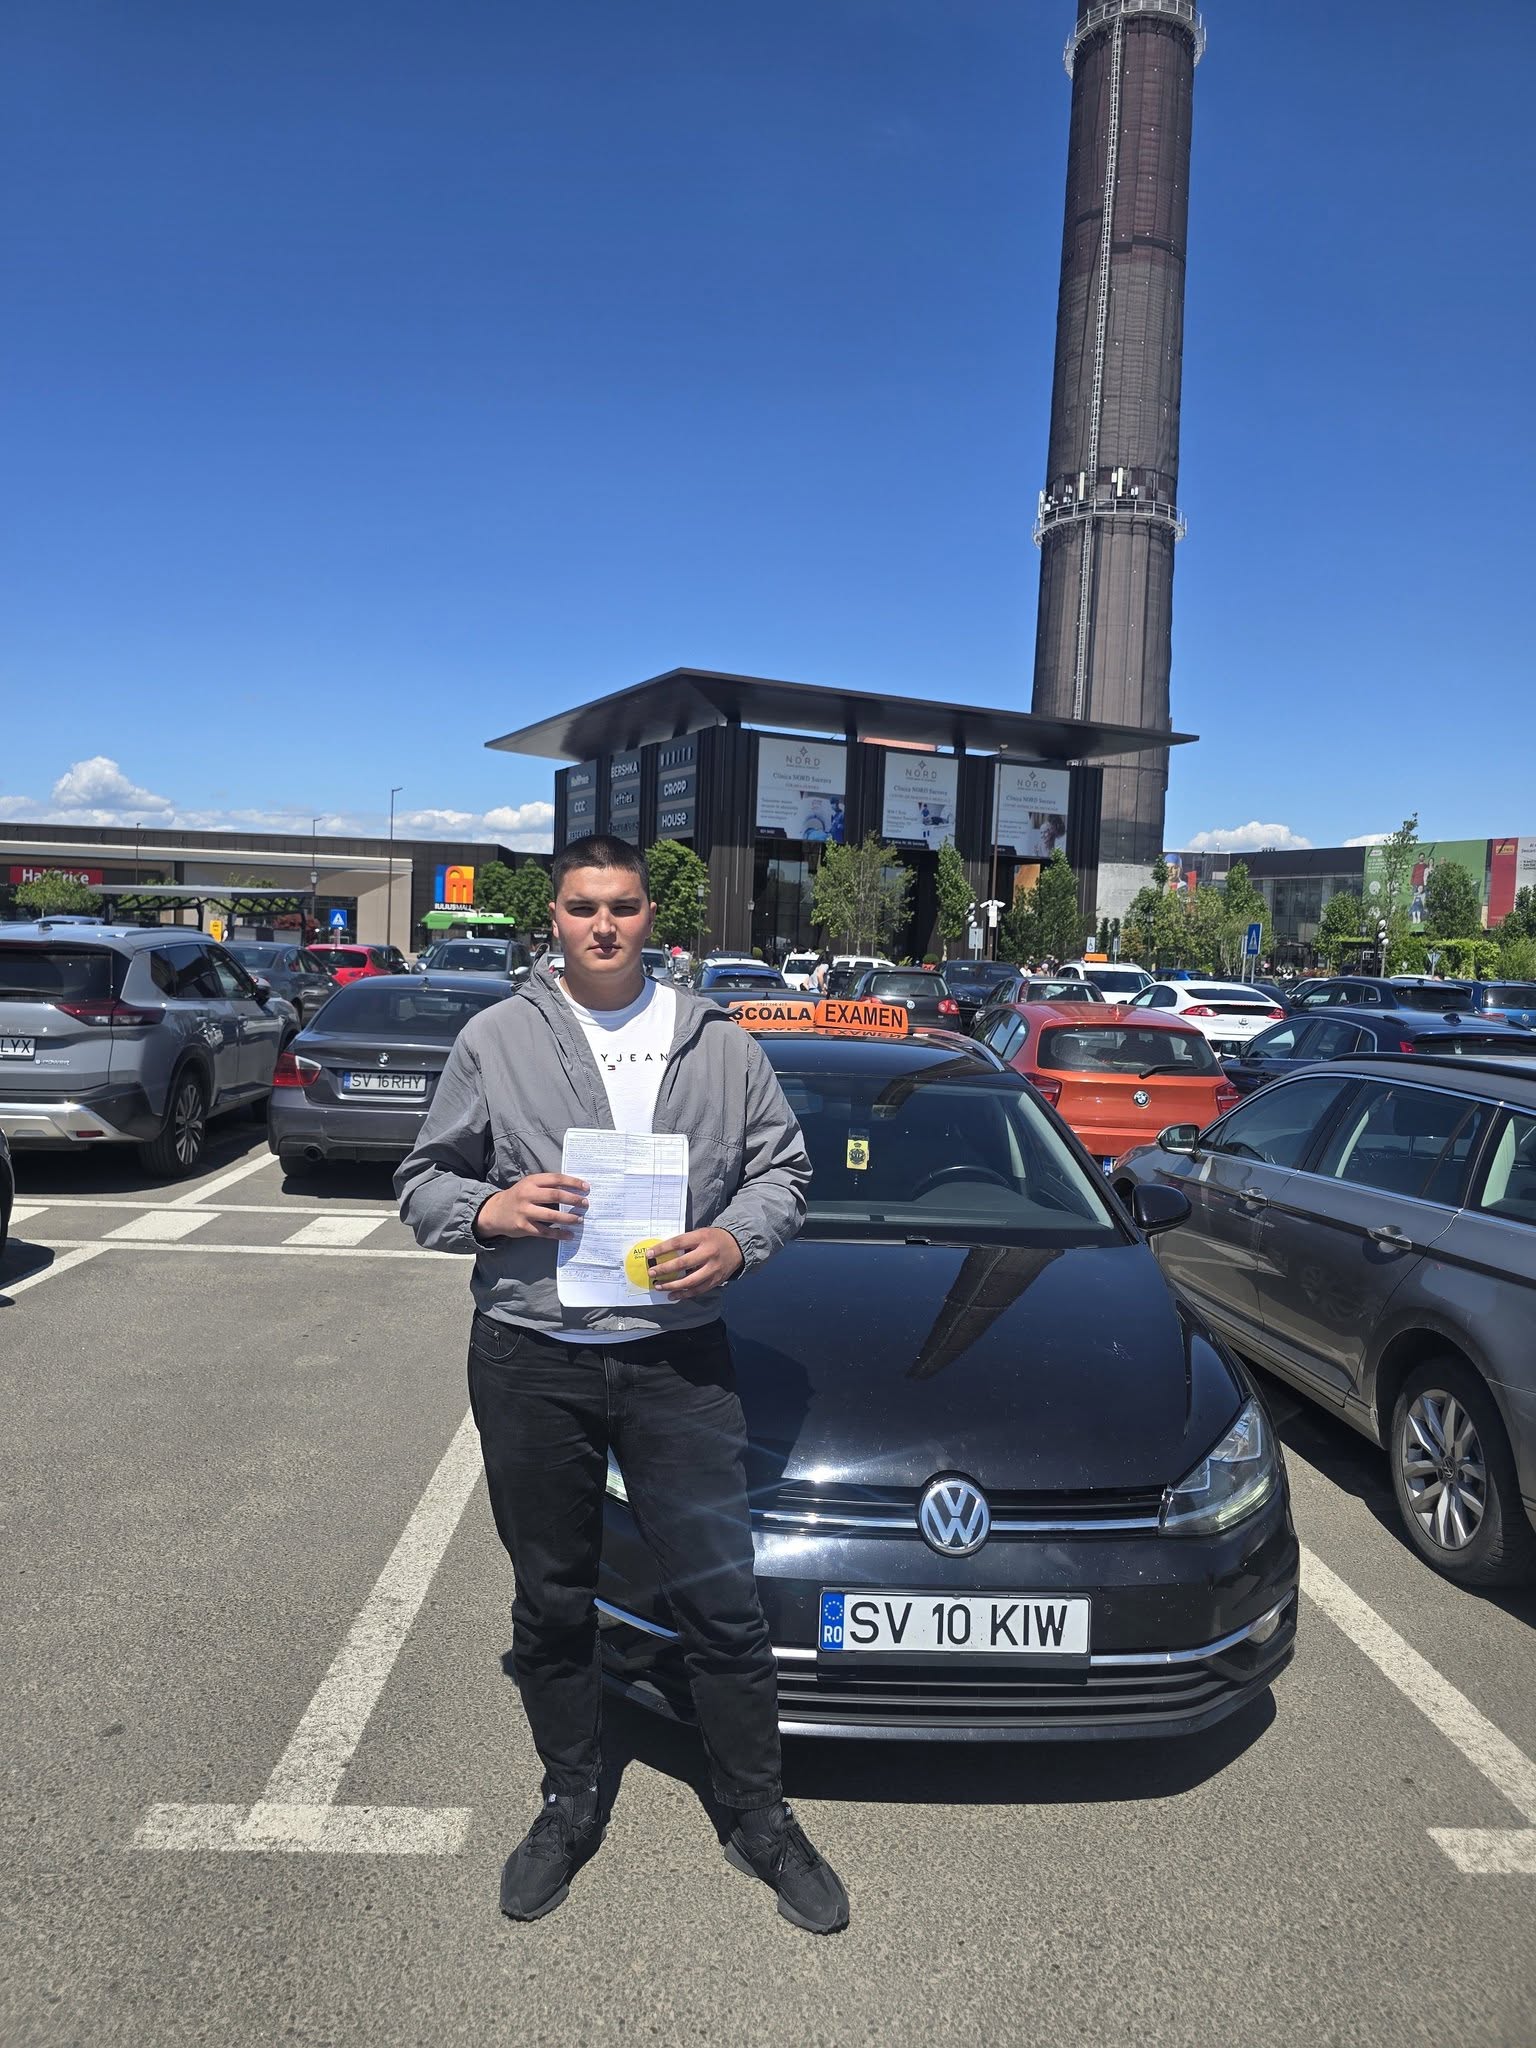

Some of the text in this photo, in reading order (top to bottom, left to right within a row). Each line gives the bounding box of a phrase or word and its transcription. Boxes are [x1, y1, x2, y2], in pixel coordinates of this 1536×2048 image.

[786, 755, 820, 766] NORD
[610, 761, 638, 779] BERSHKA
[905, 769, 937, 779] NORD
[664, 780, 687, 796] CROPP
[1017, 779, 1047, 789] NORD
[574, 800, 586, 813] CCC
[825, 1003, 903, 1028] EXAMEN
[0, 1039, 32, 1054] LYX
[352, 1073, 422, 1089] SV 16 RHY
[633, 1247, 647, 1255] AUT
[850, 1601, 1068, 1647] SV 10 KIW
[823, 1625, 843, 1643] RO
